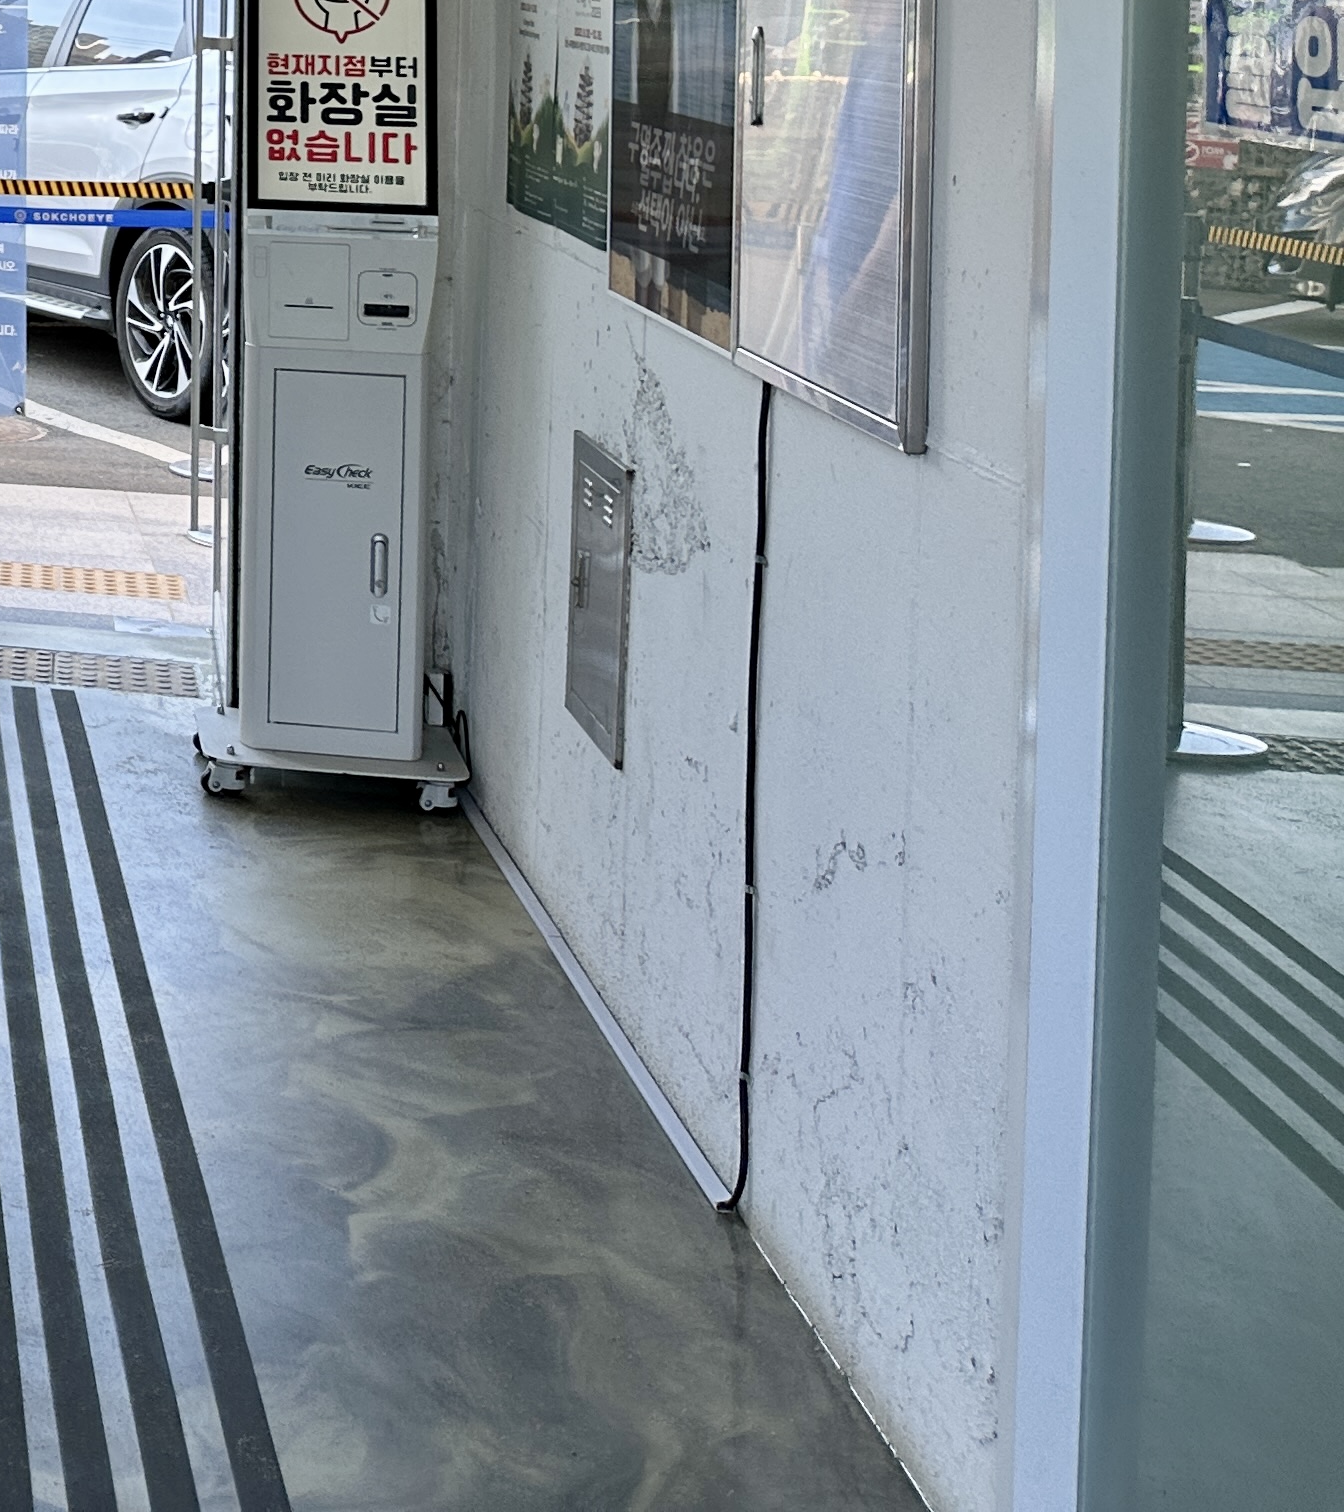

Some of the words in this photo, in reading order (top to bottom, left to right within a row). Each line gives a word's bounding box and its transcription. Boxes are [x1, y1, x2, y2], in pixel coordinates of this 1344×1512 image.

[266, 52, 418, 78] 현재지점부터
[266, 80, 418, 127] 화장실
[266, 128, 418, 165] 없습니다
[278, 171, 299, 182] 입장
[302, 172, 313, 182] 전
[316, 173, 336, 183] 미리
[340, 173, 370, 185] 화장실
[374, 174, 405, 186] 이용을
[308, 183, 372, 194] 부탁드립니다.
[32, 212, 114, 223] SOKCHOEYE
